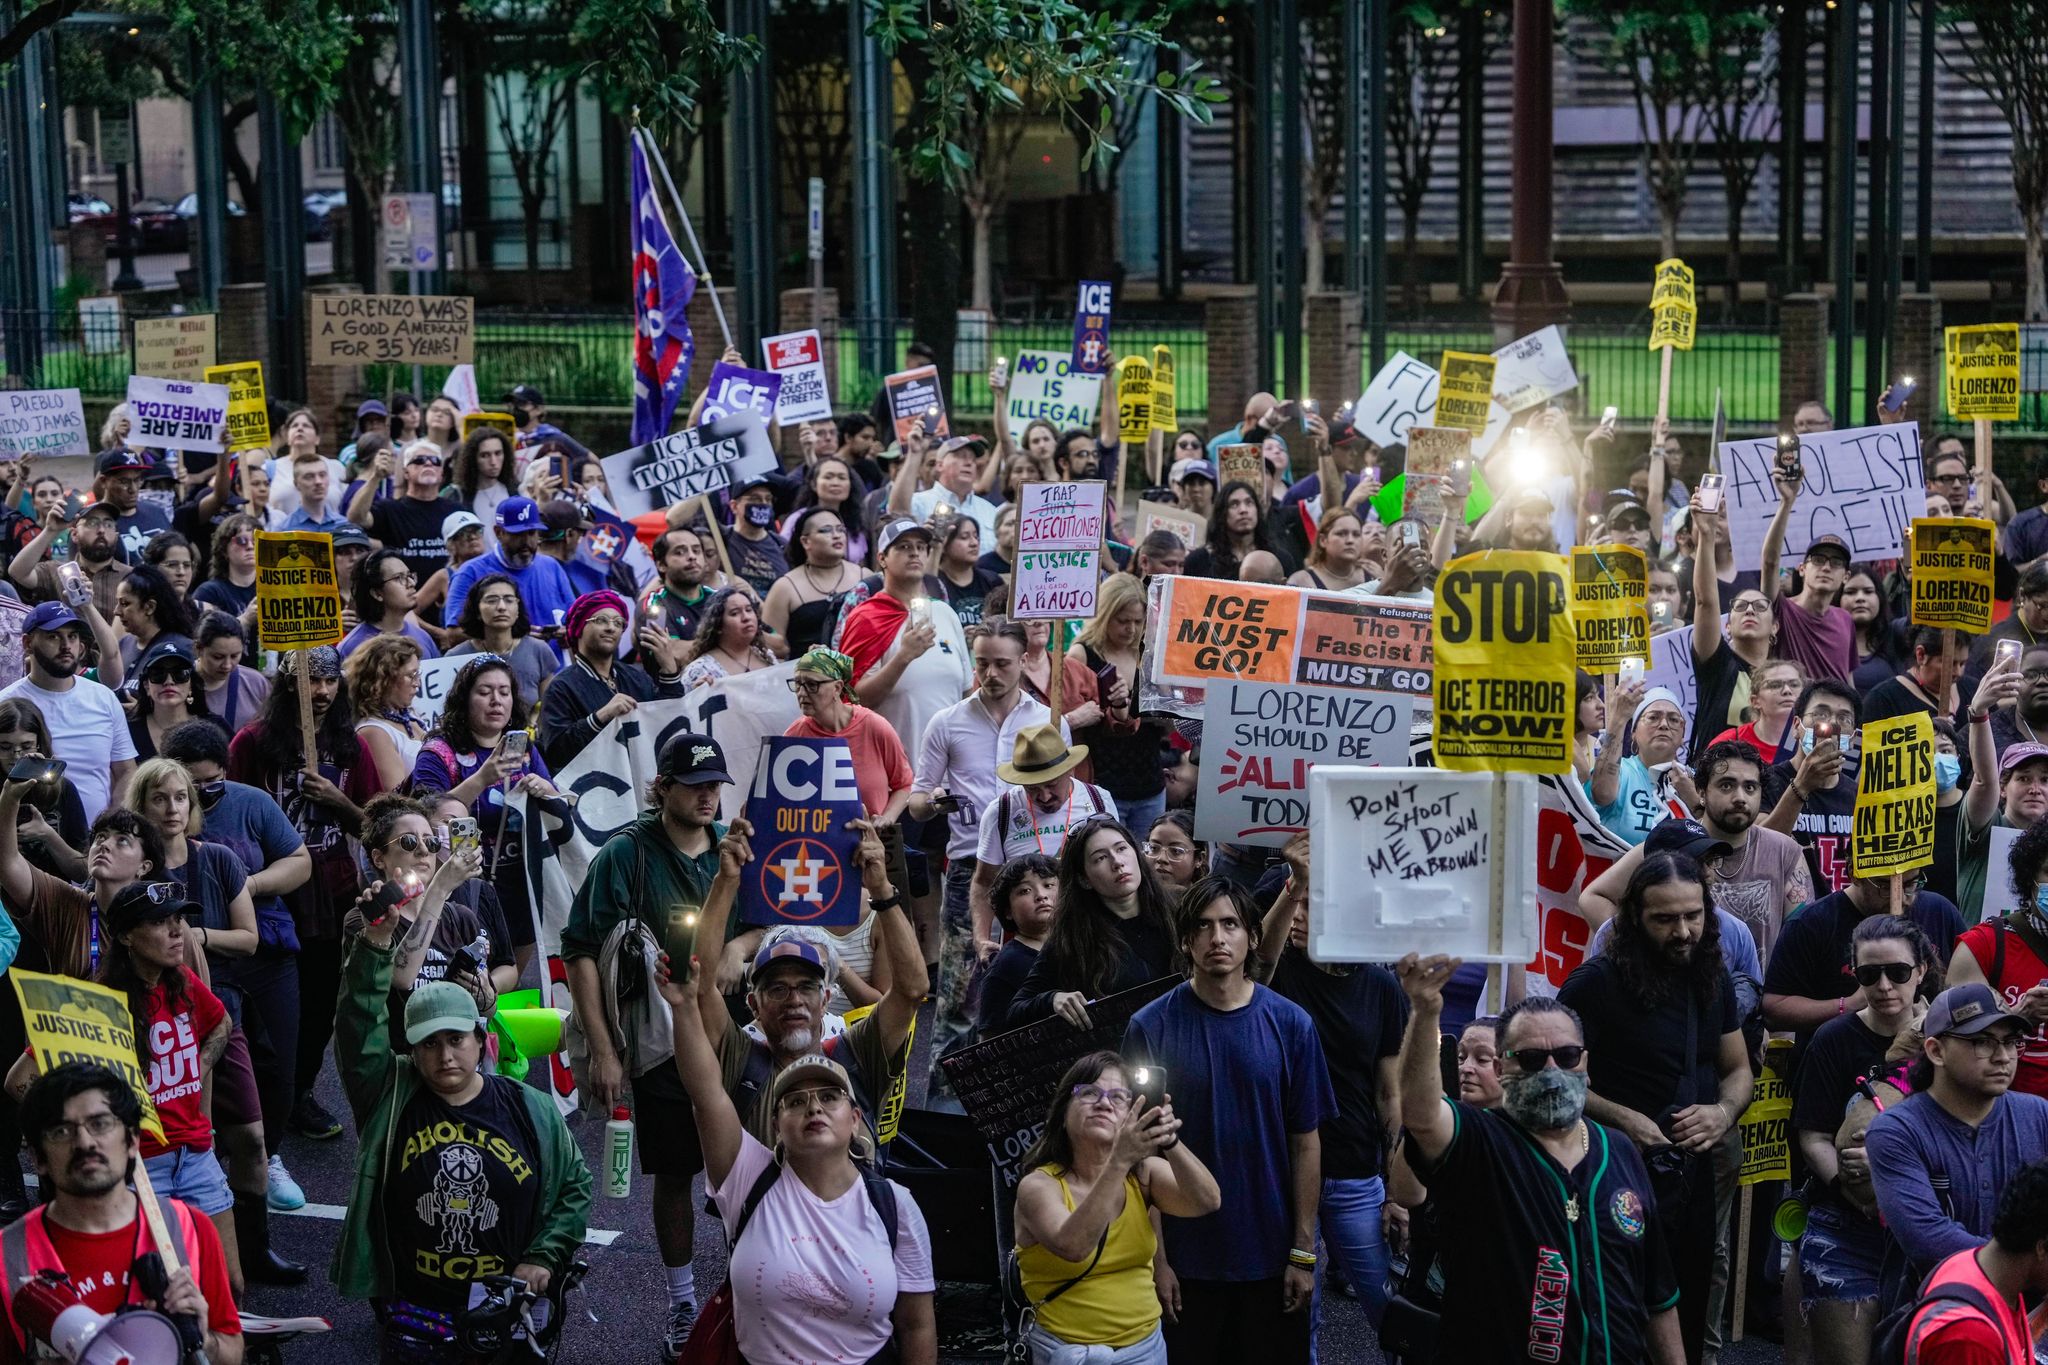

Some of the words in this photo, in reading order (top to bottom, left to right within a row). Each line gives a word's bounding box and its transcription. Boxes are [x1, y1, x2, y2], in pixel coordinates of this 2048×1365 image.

[323, 298, 415, 317] LORENZO
[418, 298, 470, 321] WAS
[1079, 284, 1112, 314] ICE
[321, 321, 334, 336] A
[343, 320, 390, 336] GOOD
[394, 319, 469, 337] AMERICAN
[330, 340, 370, 357] FOR
[375, 338, 404, 359] 35
[408, 336, 460, 361] YEARS!
[1018, 352, 1047, 375] NO
[1959, 354, 1996, 368] JUSTICE
[1998, 354, 2017, 367] FOR
[798, 369, 817, 382] OFF
[1959, 377, 2016, 395] LORENZO
[166, 384, 193, 395] SEIU
[718, 378, 770, 411] ICE
[1043, 378, 1062, 398] IS
[10, 393, 64, 414] PUEBLO
[131, 399, 223, 425] AMERICA.
[1010, 398, 1090, 426] ILLEGAL
[1120, 403, 1150, 418] CE
[1439, 397, 1488, 417] LORENZO
[32, 411, 81, 432] JAMAS
[140, 418, 178, 435] ARE
[226, 410, 266, 430] RENZO
[19, 431, 80, 451] VENCIDO
[181, 424, 213, 441] WE
[651, 429, 701, 460] ICE
[633, 438, 739, 490] TODAYS
[661, 465, 731, 505] NAZI
[1041, 485, 1078, 503] TRAP
[1021, 515, 1101, 542] EXECUTIONER
[402, 547, 418, 557] las
[425, 536, 445, 547] cub
[1022, 552, 1091, 571] JUSTICE
[1916, 552, 1966, 568] JUSTICE
[1969, 554, 1991, 572] FOR
[259, 568, 307, 586] JUSTICE
[310, 568, 333, 586] FOR
[1044, 570, 1058, 584] for
[1017, 589, 1093, 611] ARAUJO
[1575, 583, 1620, 601] JUSTICE
[1622, 581, 1646, 598] FOR
[1916, 580, 1991, 604] LORENZO
[260, 596, 337, 620] LORENZO
[1203, 594, 1269, 623] ICE
[1440, 569, 1567, 644] STOP
[1915, 601, 1955, 612] SALGADO
[1956, 601, 1989, 618] ARAUJO
[262, 620, 302, 633] SALGADO
[304, 618, 339, 632] ARAUJO
[1176, 618, 1288, 652] MUST
[1353, 617, 1400, 640] The
[1576, 615, 1646, 642] LORENZO
[1316, 635, 1411, 663] Fascist
[1576, 642, 1616, 655] SALGADO
[1193, 647, 1262, 675] GO!
[1306, 661, 1384, 686] MUST
[1439, 679, 1472, 711] ICE
[1477, 678, 1566, 714] TERROR
[1230, 685, 1397, 734] LORENZO
[1439, 714, 1566, 739] NOW!
[1881, 724, 1917, 747] ICE
[1234, 724, 1328, 752] SHOULD
[1338, 735, 1373, 760] BE
[1512, 744, 1520, 754] &
[752, 743, 859, 802] ICE
[1238, 755, 1315, 790] ALI
[1863, 740, 1932, 794] MELTS
[1347, 780, 1418, 821] DON'T
[776, 807, 806, 834] OUT
[812, 808, 833, 833] OF
[1384, 791, 1460, 840] SHOOT
[1856, 804, 1878, 836] IN
[1882, 794, 1934, 834] TEXAS
[1012, 826, 1051, 841] CHINGA
[1367, 837, 1411, 879] ME
[1420, 807, 1479, 855] DOWN
[1856, 825, 1933, 855] HEAT
[1858, 855, 1873, 867] PARTY
[1874, 854, 1884, 865] FOR
[32, 1012, 107, 1045] JUSTICE
[150, 1011, 196, 1056] CE
[1739, 1118, 1788, 1149] RENZO
[401, 1120, 534, 1185] ABOLISH
[611, 1131, 631, 1186] MEX
[1753, 1143, 1787, 1162] ARAUJO
[416, 1249, 505, 1281] ICE
[1528, 1244, 1571, 1364] MEXICO
